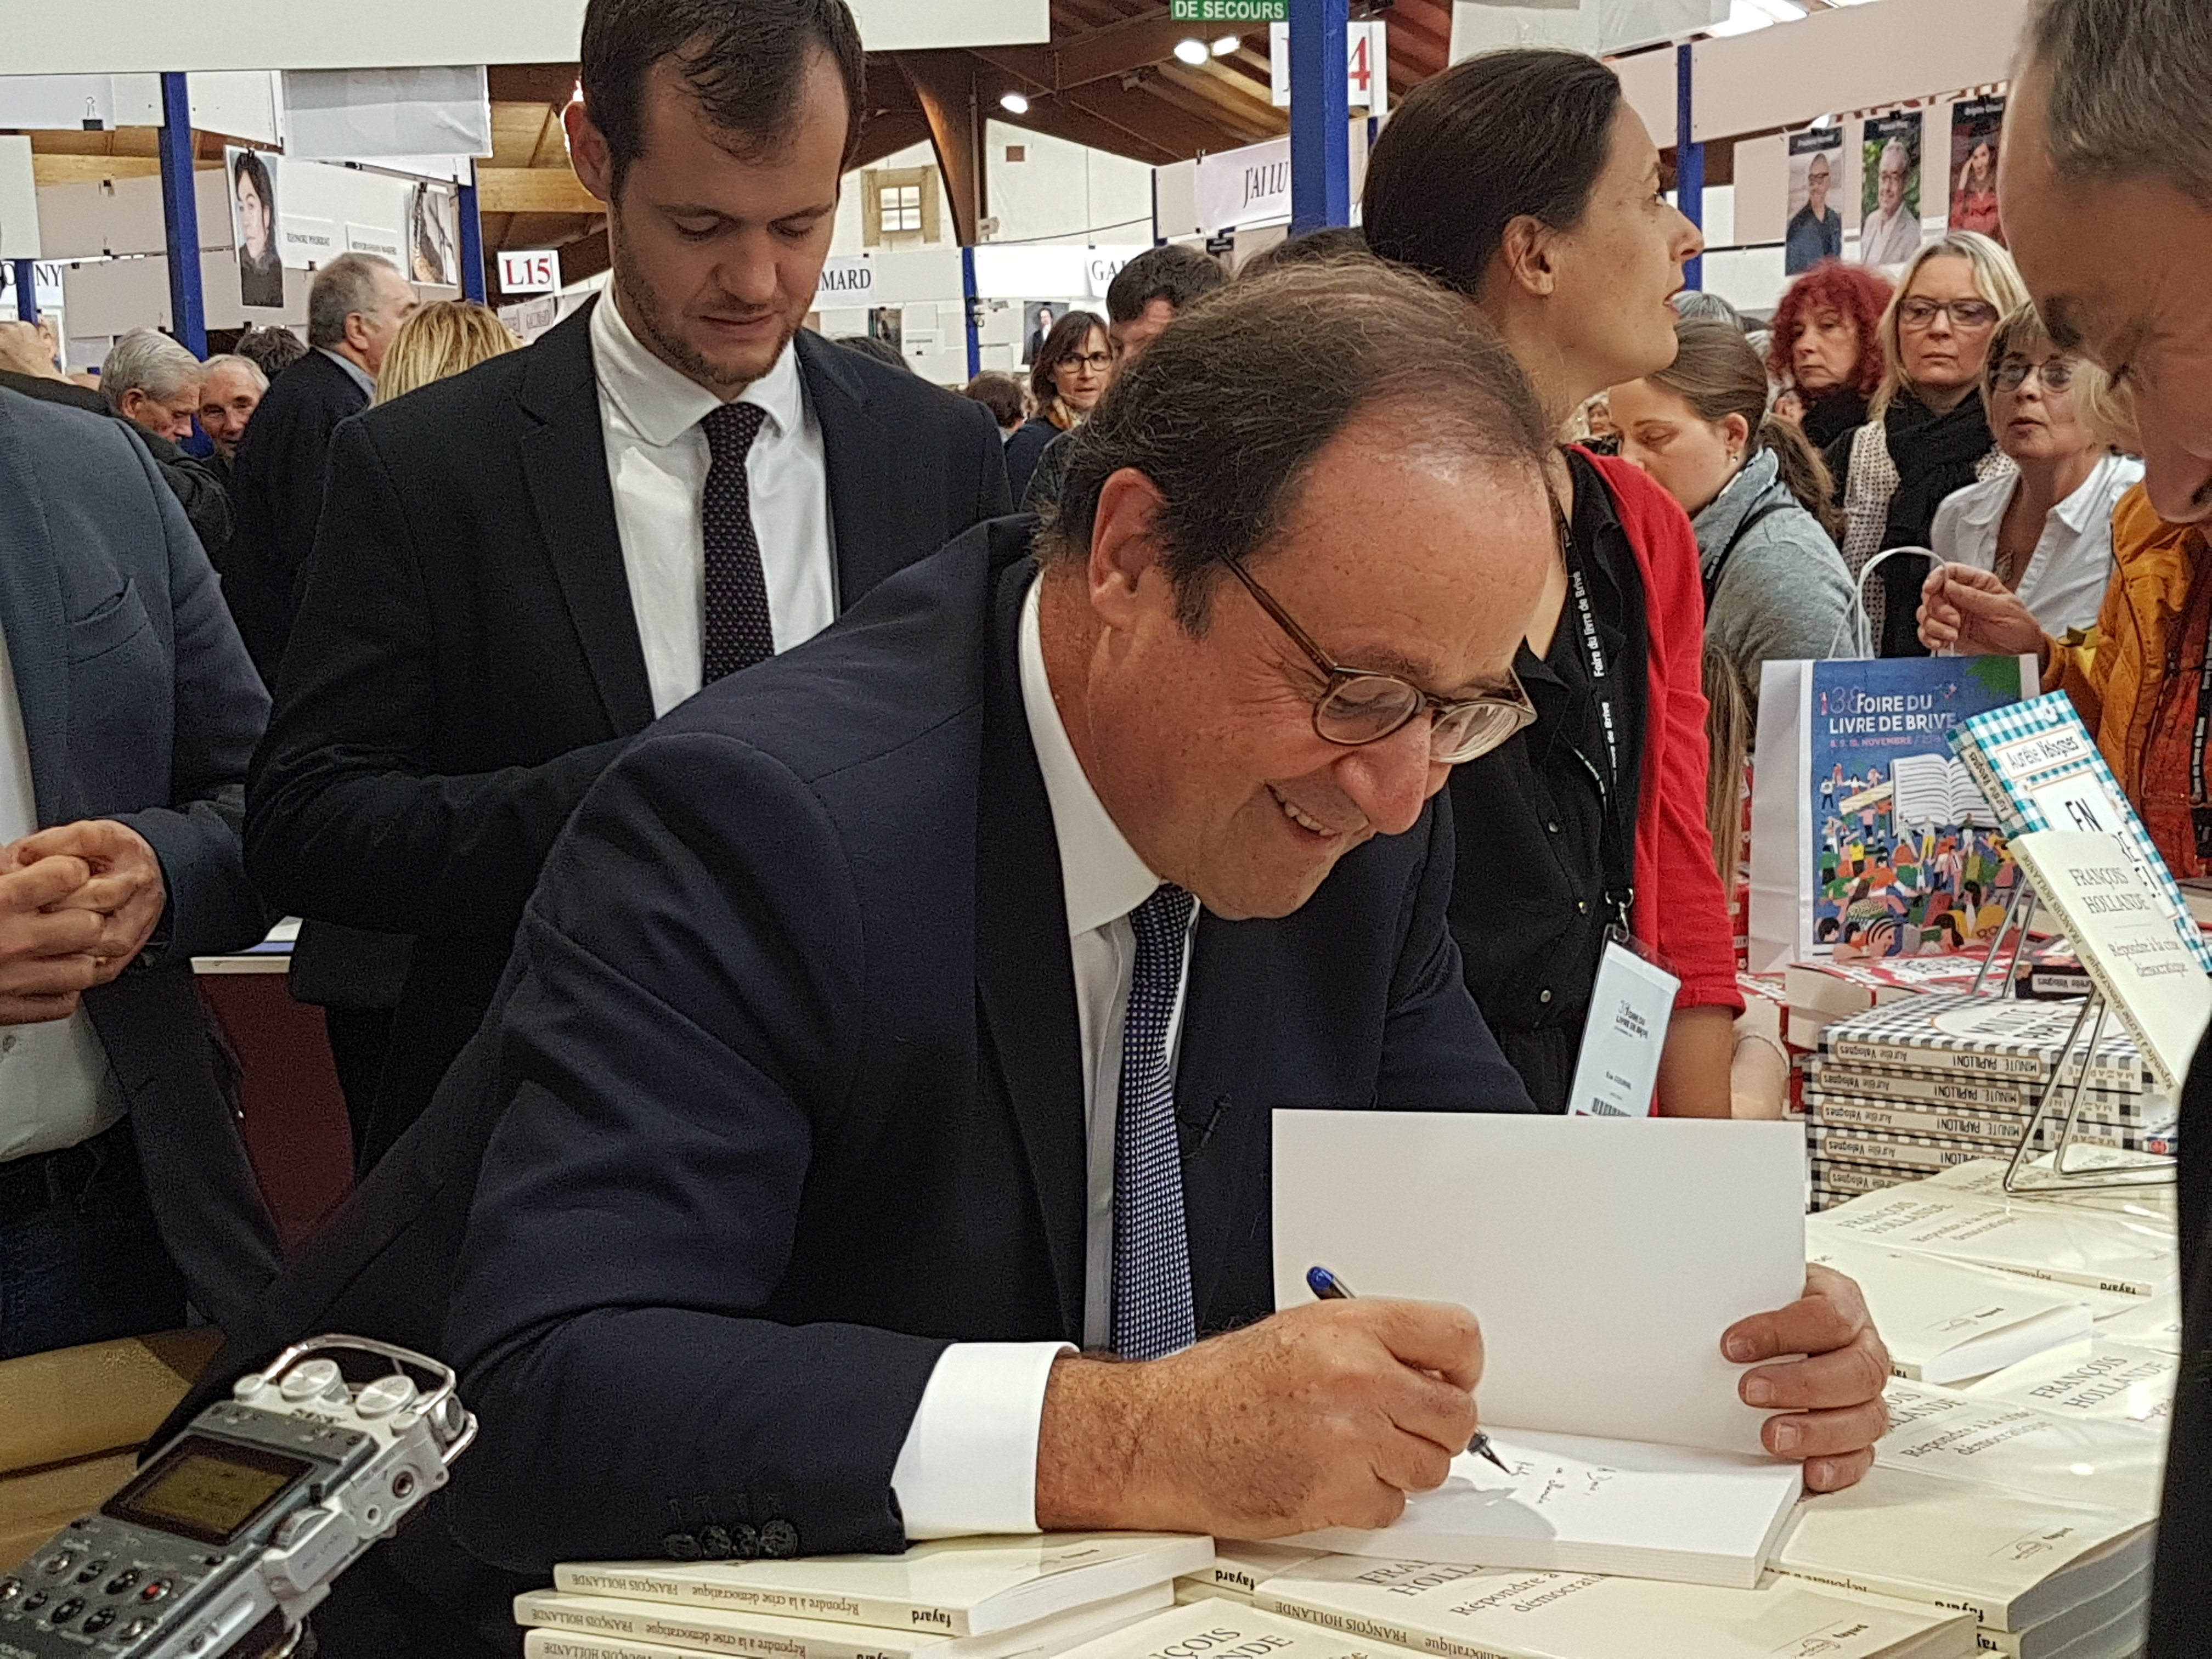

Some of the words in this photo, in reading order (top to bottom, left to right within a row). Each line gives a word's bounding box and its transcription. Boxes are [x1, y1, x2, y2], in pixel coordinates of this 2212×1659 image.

[1175, 1, 1198, 18] DE
[1204, 1, 1284, 19] SECOURS
[1243, 166, 1266, 208] J'AI
[1269, 162, 1288, 194] LU
[504, 257, 551, 285] L15
[818, 269, 871, 291] MARD
[1587, 636, 1599, 650] du
[1592, 651, 1605, 678] Foire
[1857, 693, 1904, 714] FOIRE
[1908, 694, 1932, 712] DU
[1829, 716, 1876, 734] LIVRE
[1879, 715, 1903, 731] DE
[1906, 713, 1957, 733] BRIVE
[2068, 867, 2129, 890] FRANÇOIS
[2081, 893, 2151, 914] HOLLANDE
[2029, 1356, 2129, 1400] FRANÇOIS
[2063, 1361, 2174, 1409] HOLLANDE
[572, 1573, 626, 1589] HOLLANDE
[629, 1578, 678, 1595] FRANÇOIS
[1216, 1570, 1255, 1591] fayard
[692, 1583, 759, 1605] démocratique
[763, 1592, 786, 1605] crise
[1449, 1576, 1542, 1616] Répondre
[531, 1608, 584, 1624] HOLLANDE
[809, 1598, 860, 1616] Répondre
[1274, 1601, 1342, 1628] HOLLANDE
[585, 1615, 633, 1633] FRANÇOIS
[912, 1610, 951, 1628] fayard
[1346, 1618, 1408, 1644] FRANÇOIS
